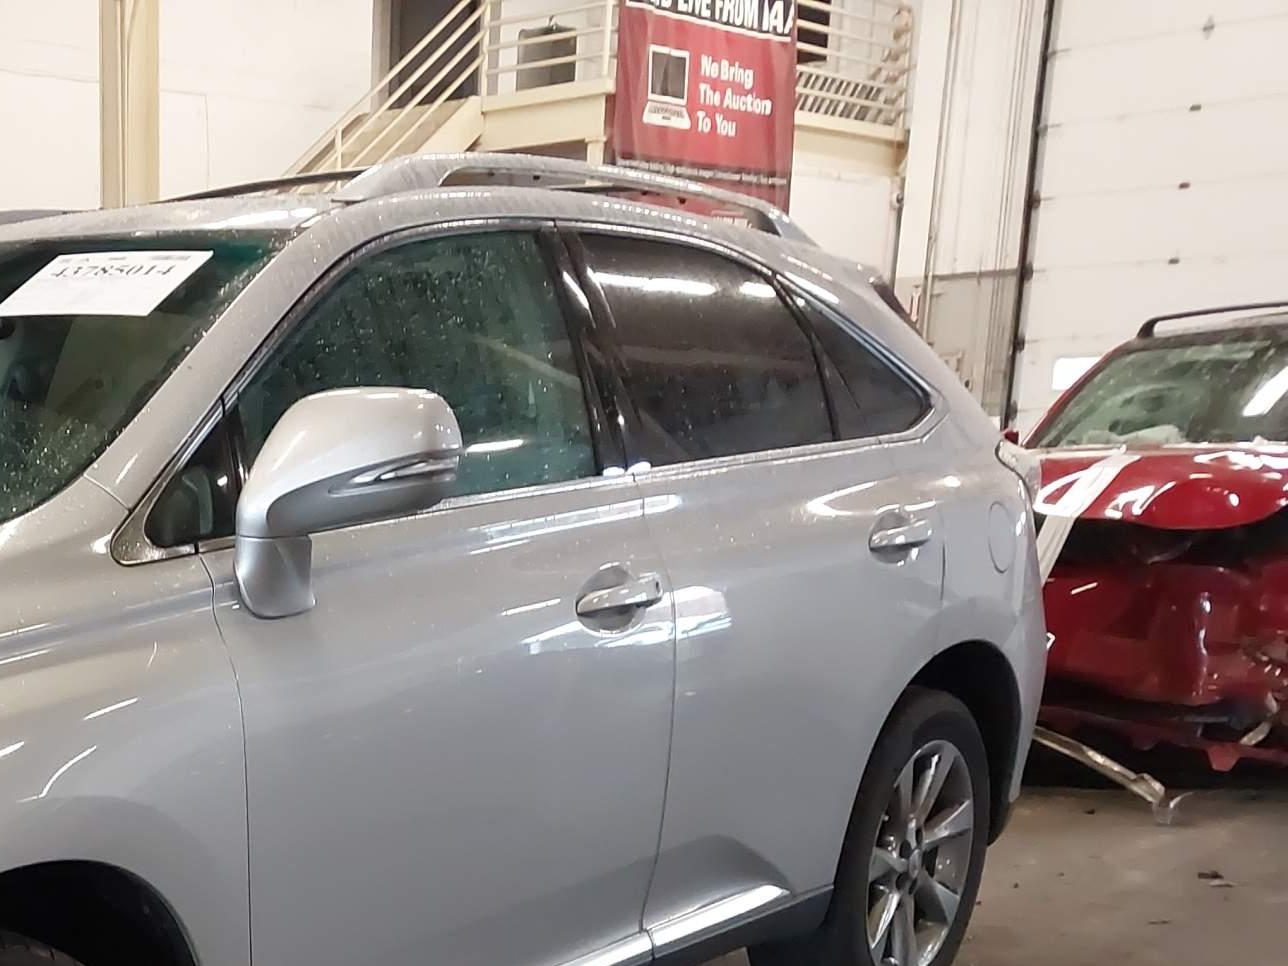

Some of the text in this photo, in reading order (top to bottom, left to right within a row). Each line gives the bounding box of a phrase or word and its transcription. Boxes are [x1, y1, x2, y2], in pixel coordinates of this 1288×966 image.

[715, 0, 759, 29] FROM
[720, 59, 754, 90] Bring
[699, 83, 772, 116] The Auction
[697, 110, 737, 137] To You
